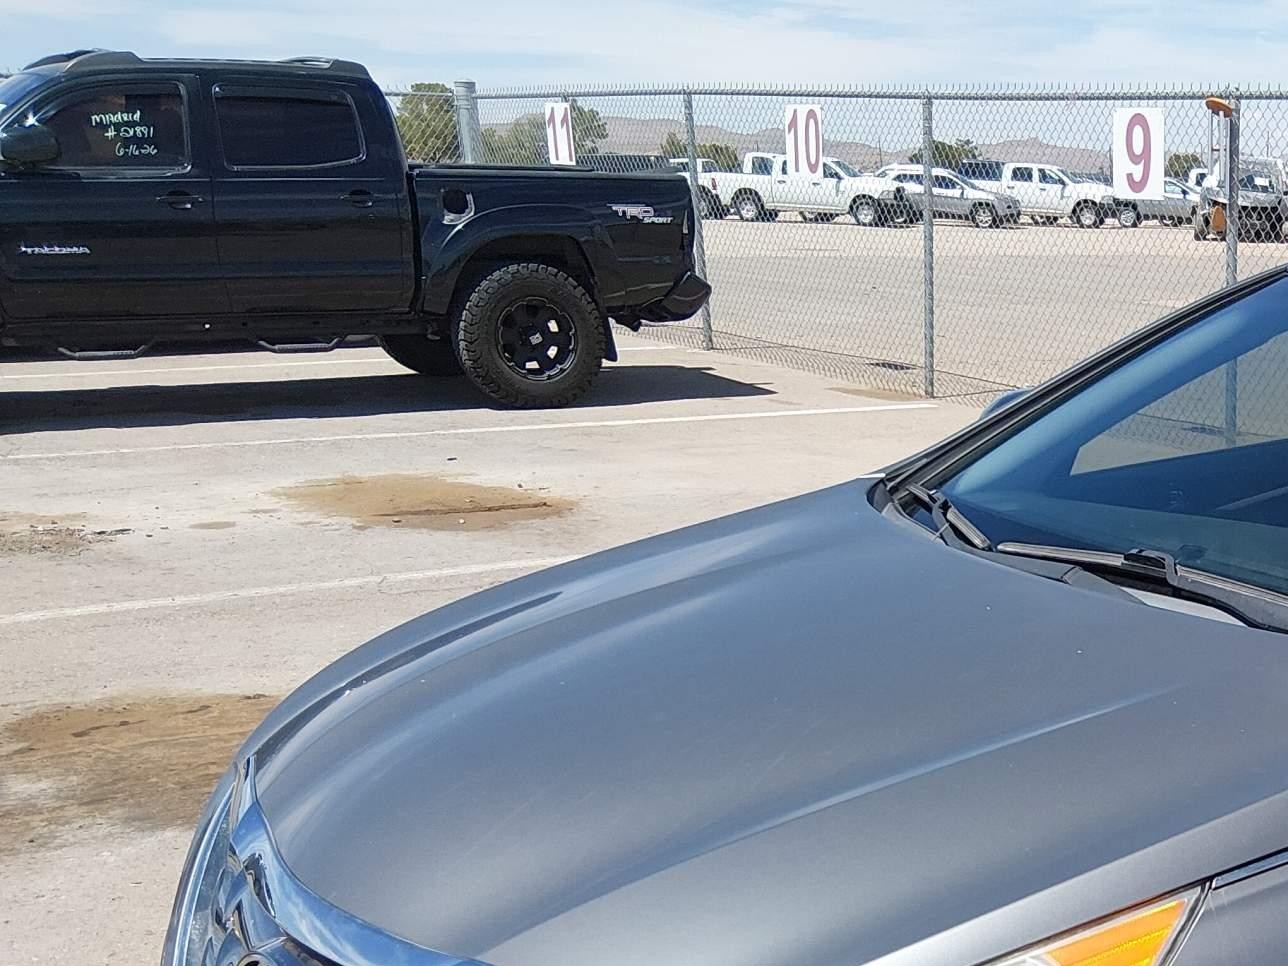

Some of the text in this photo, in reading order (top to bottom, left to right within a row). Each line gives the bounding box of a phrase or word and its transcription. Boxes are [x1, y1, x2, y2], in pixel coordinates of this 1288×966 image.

[547, 107, 573, 162] 11
[788, 109, 820, 174] 10
[1126, 113, 1151, 193] 9
[642, 216, 673, 224] SPORT
